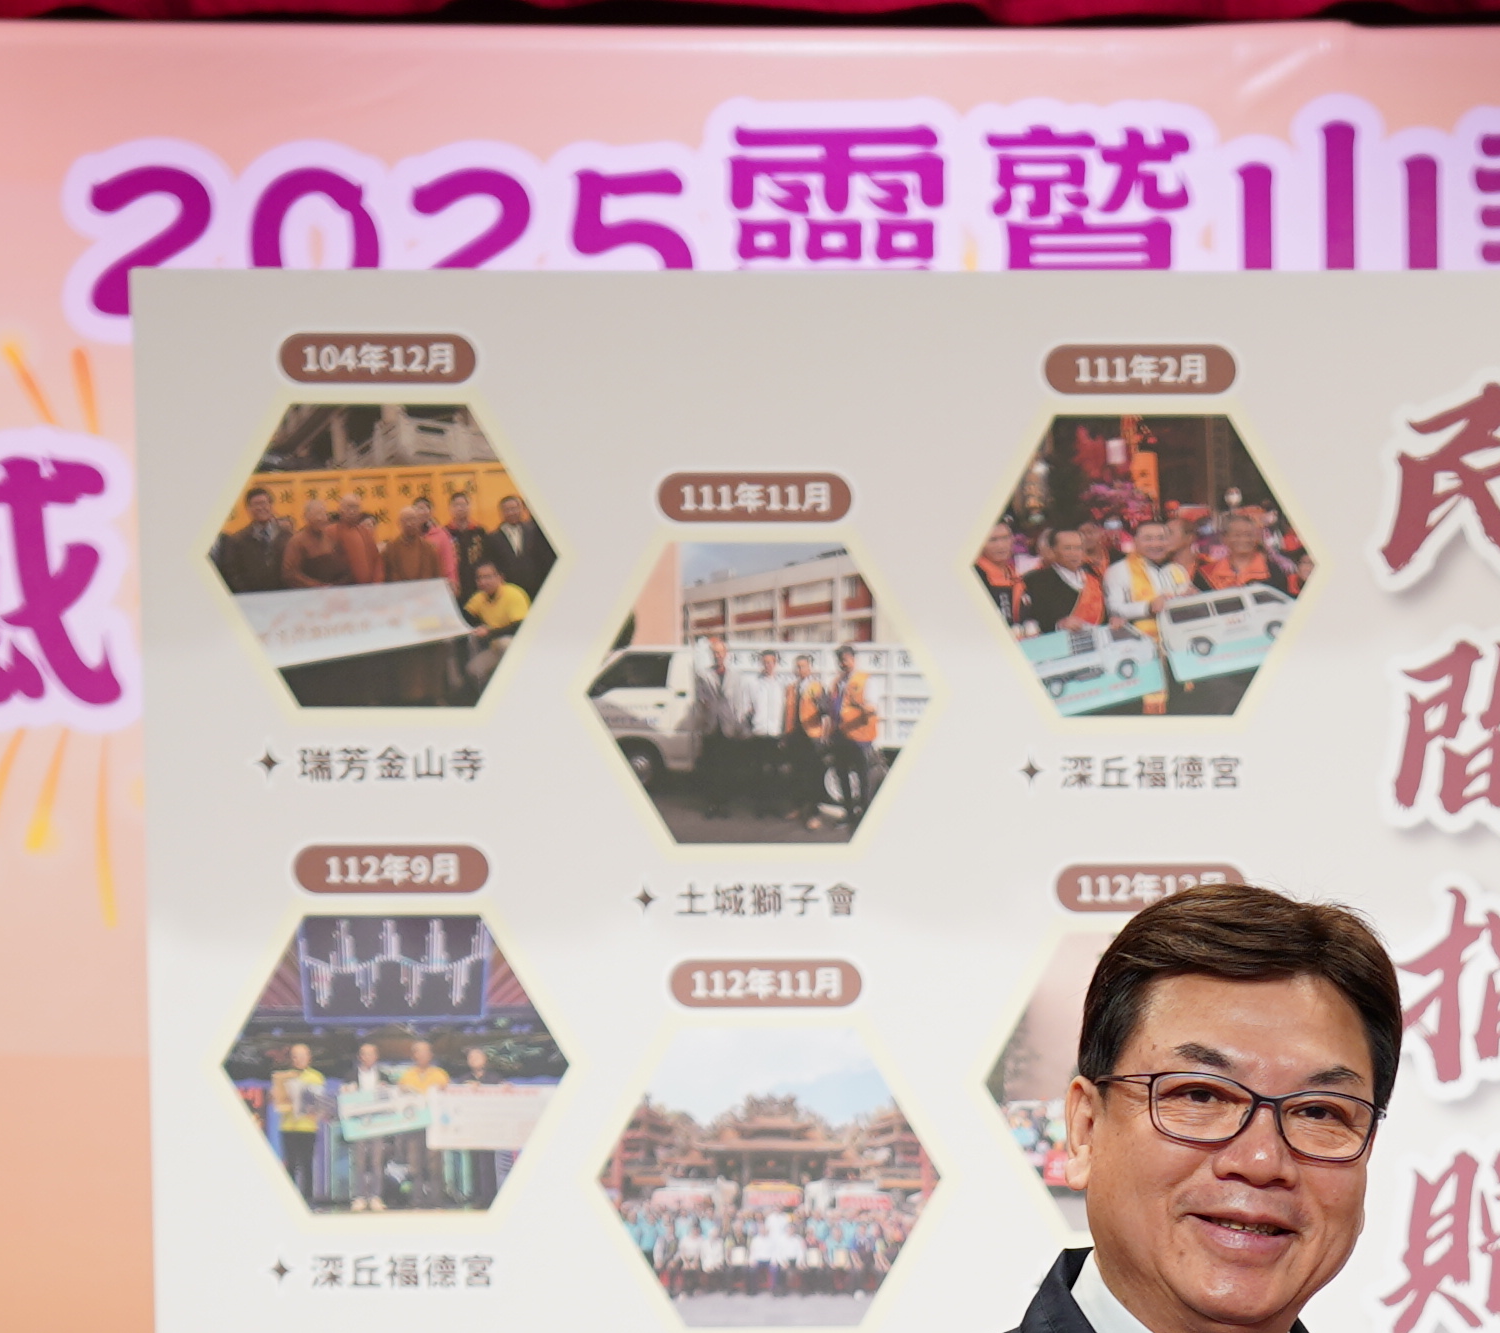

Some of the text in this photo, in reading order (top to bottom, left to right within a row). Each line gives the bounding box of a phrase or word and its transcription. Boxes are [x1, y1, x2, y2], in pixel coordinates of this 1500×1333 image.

[302, 342, 455, 376] 104年12月
[1074, 353, 1207, 387] 111年2月
[681, 482, 831, 515] 111年11月
[297, 747, 486, 782] 瑞芳金山寺
[325, 853, 461, 887] 112年9月
[676, 884, 857, 919] 土城獅子會
[690, 969, 842, 1001] 112年11月
